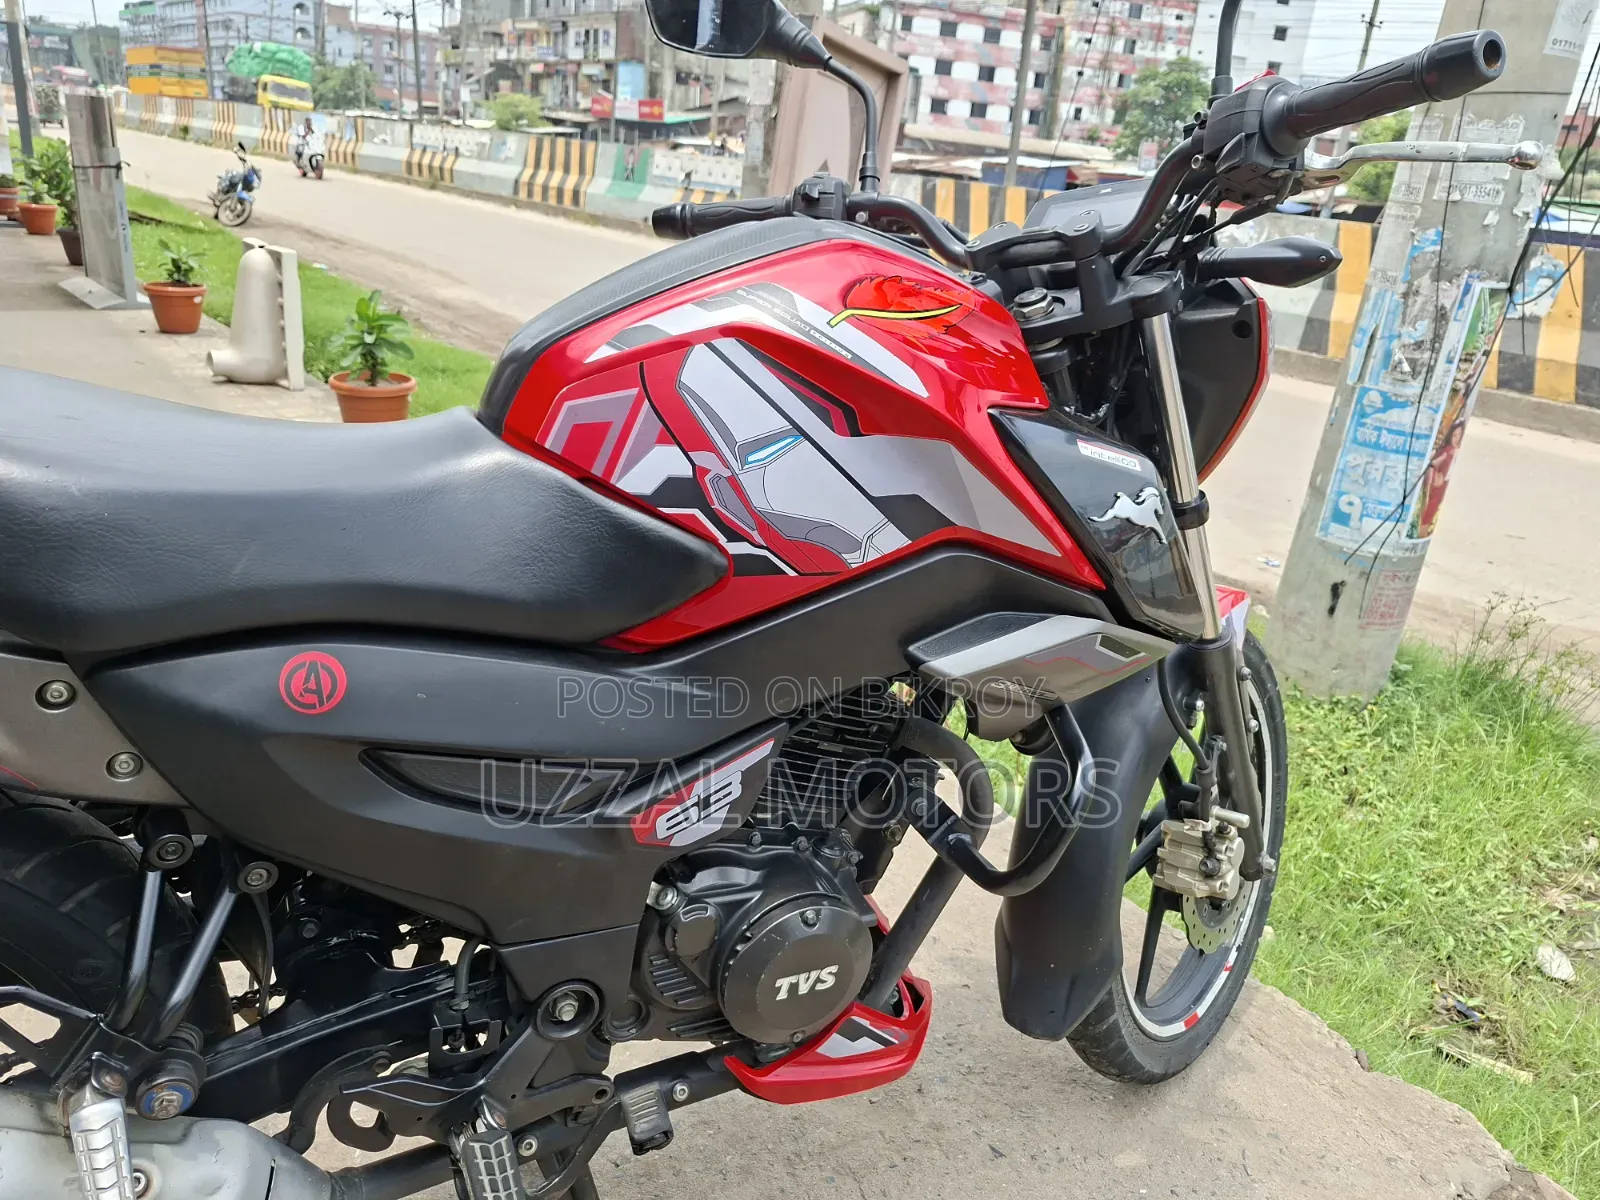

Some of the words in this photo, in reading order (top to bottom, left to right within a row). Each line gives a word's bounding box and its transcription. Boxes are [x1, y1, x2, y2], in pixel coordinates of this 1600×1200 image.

[736, 289, 772, 309] SUPER
[772, 306, 810, 332] SQUAD
[775, 965, 839, 1000] TVS
